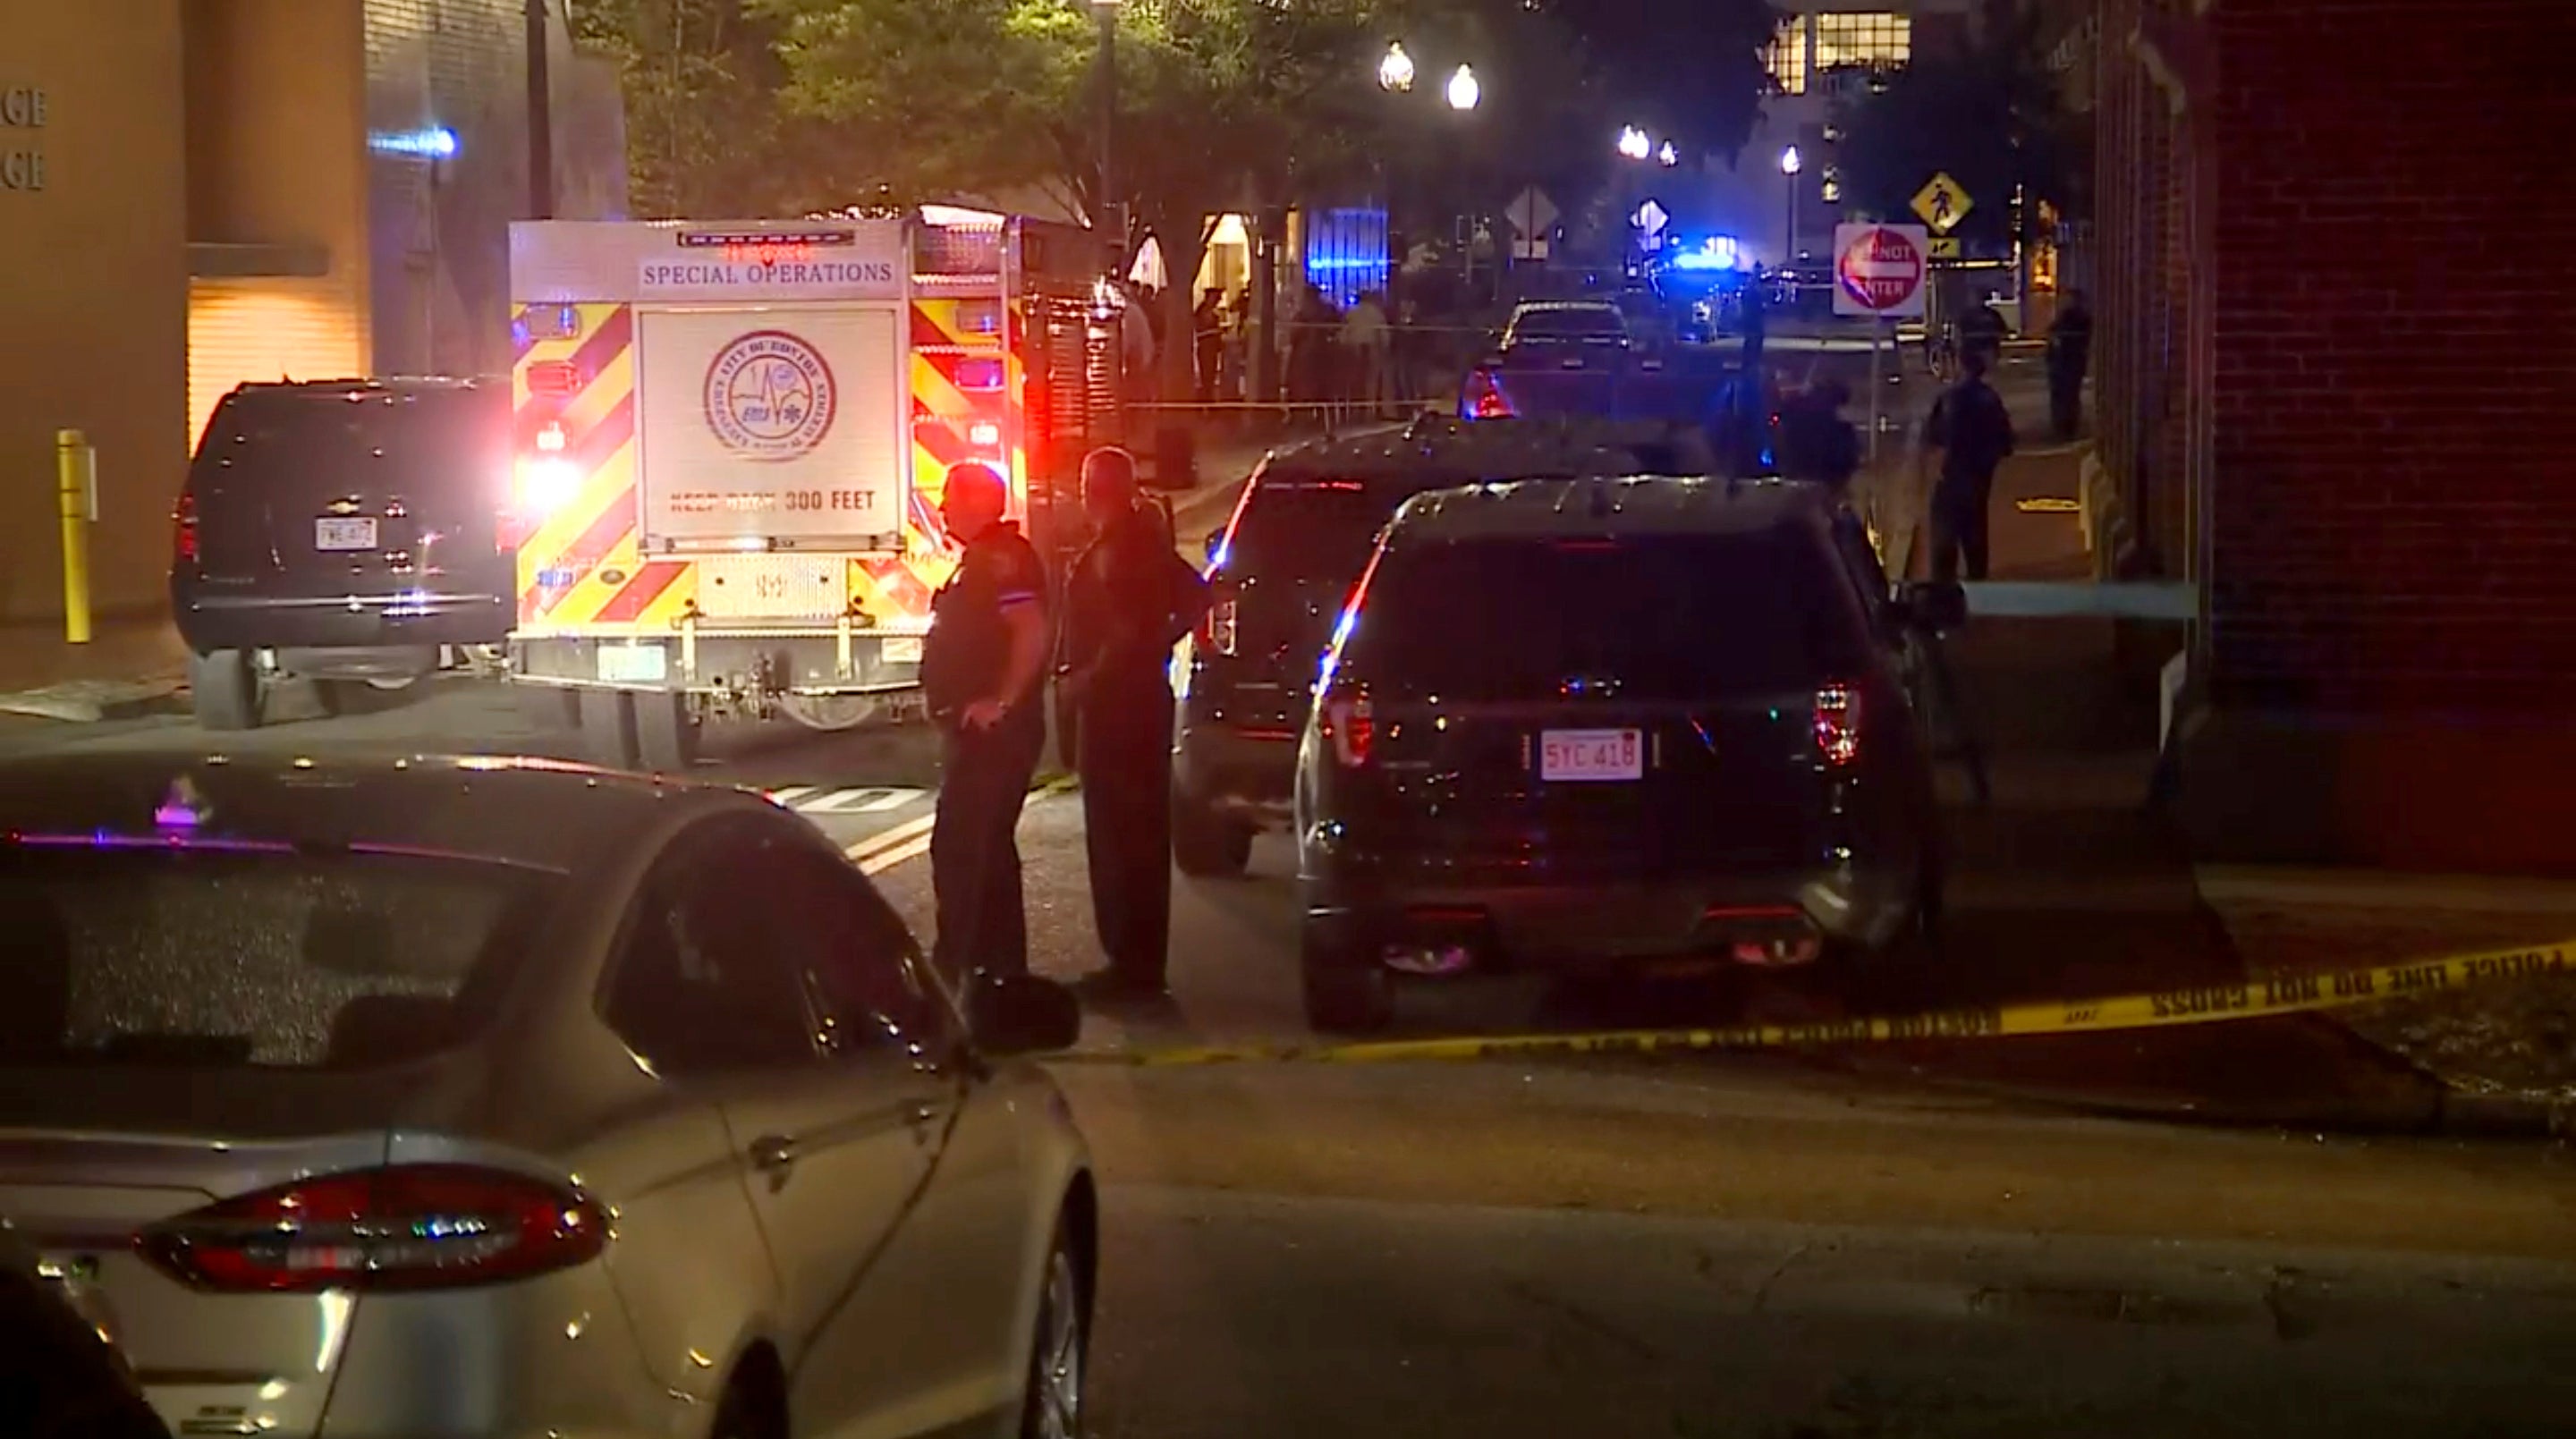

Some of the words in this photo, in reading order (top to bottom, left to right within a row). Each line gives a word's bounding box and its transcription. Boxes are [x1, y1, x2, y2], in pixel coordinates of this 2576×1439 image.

[0, 88, 47, 126] GE
[0, 150, 45, 190] GE
[644, 266, 738, 284] SPECIAL
[746, 264, 892, 284] OPERATIONS
[785, 490, 823, 512] 300
[831, 490, 877, 511] FEET
[1593, 741, 1636, 766] 418
[2386, 961, 2446, 991] LINE
[2462, 948, 2563, 980] POLICE
[2266, 977, 2318, 1005] NOT
[2334, 969, 2375, 996] DO
[2151, 986, 2249, 1018] CROSS
